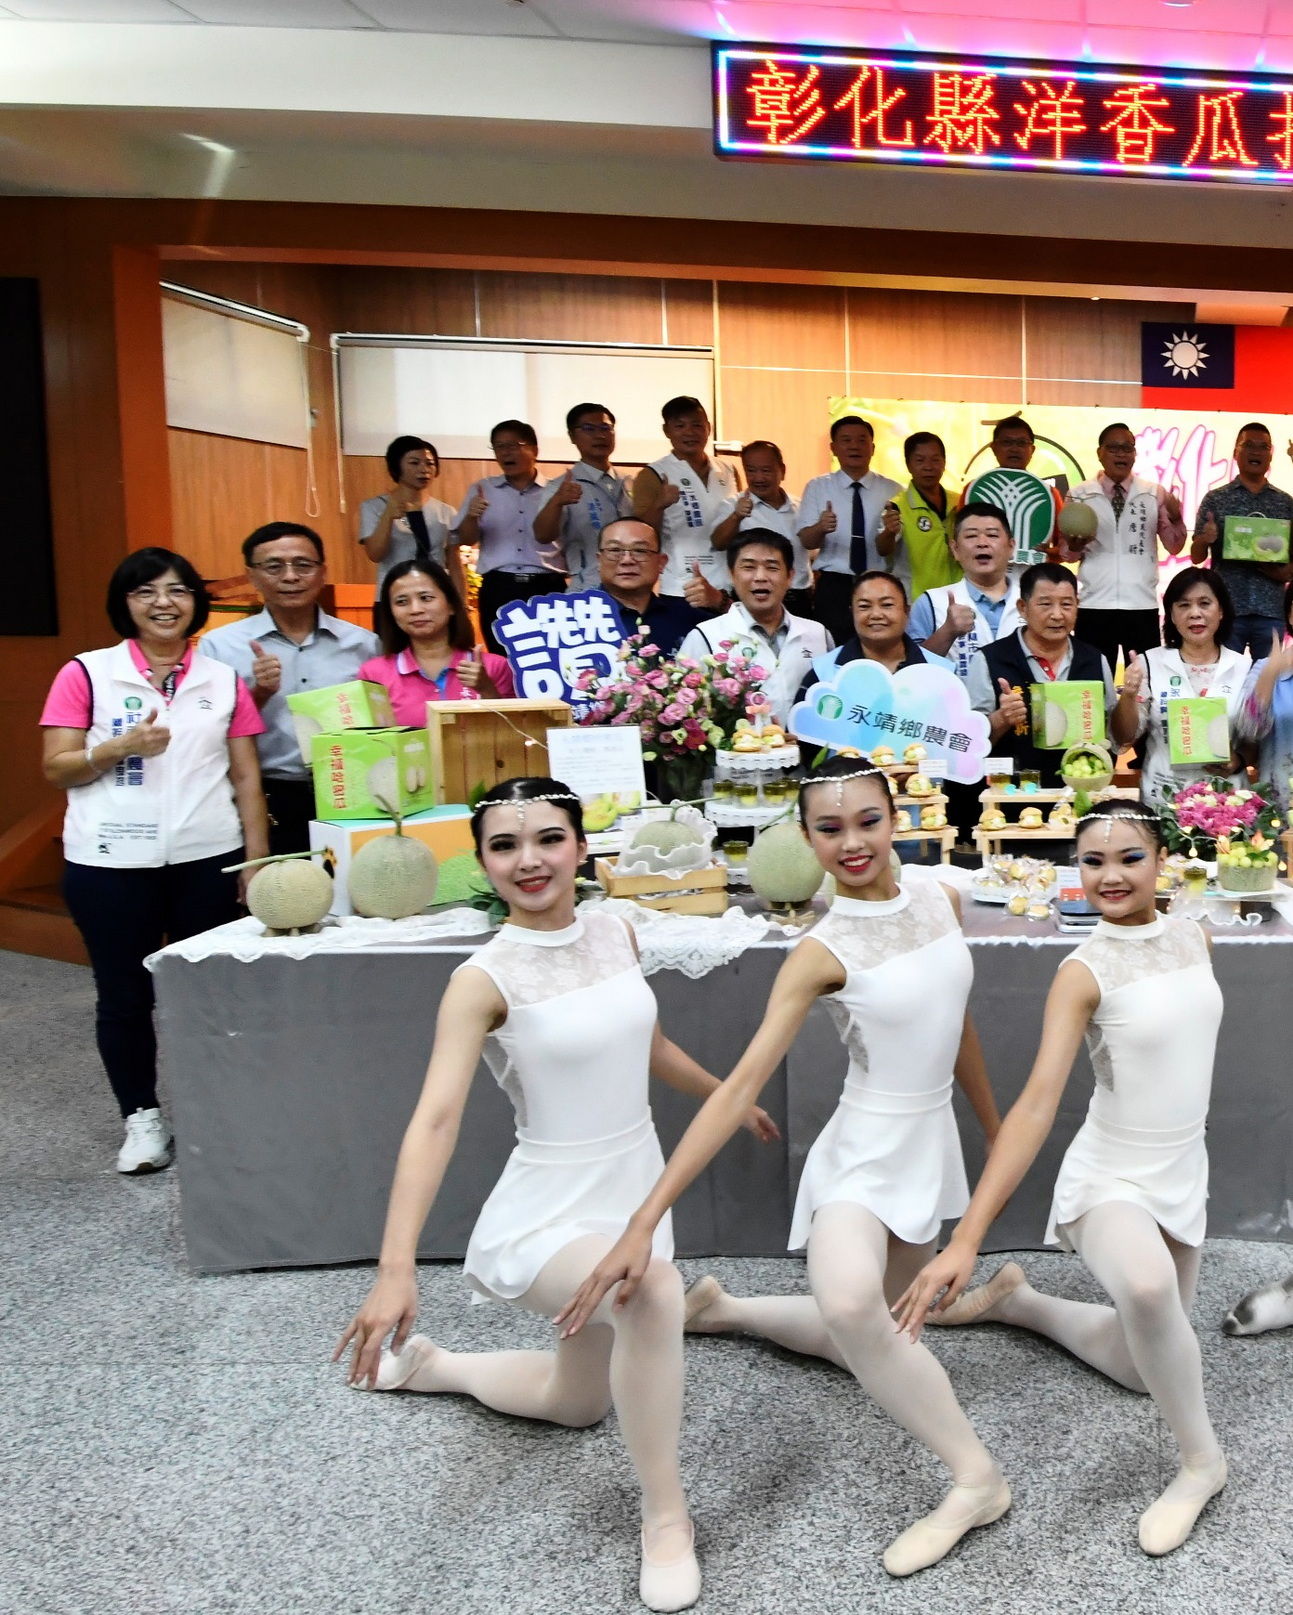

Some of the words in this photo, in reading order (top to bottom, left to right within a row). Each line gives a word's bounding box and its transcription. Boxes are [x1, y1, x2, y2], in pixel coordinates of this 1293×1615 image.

[501, 596, 635, 702] 讚
[847, 704, 973, 753] 永靖鄉農會
